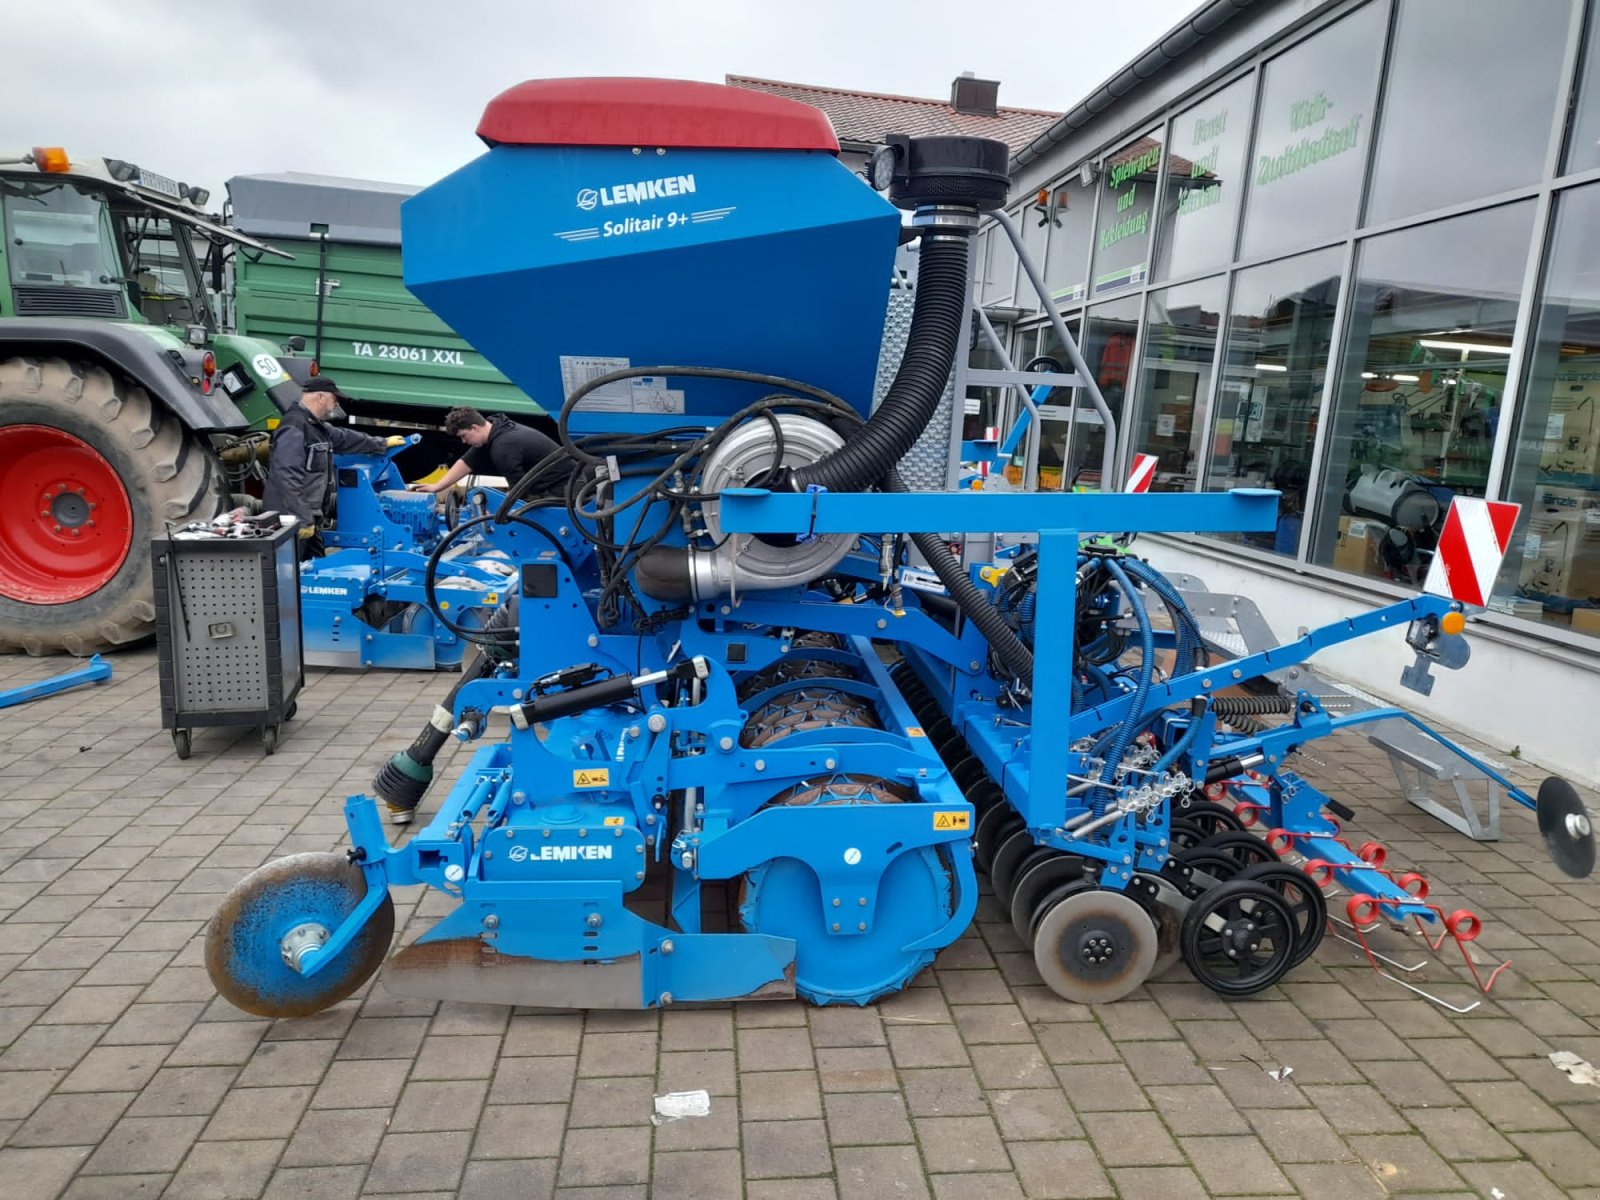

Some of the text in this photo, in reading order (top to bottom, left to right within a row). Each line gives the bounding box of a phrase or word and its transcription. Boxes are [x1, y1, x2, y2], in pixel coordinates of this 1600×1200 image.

[1110, 146, 1160, 189] Spielwaren
[600, 173, 696, 206] LEMKEN
[1117, 182, 1137, 213] und
[603, 211, 689, 237] Solitair 9+
[1099, 206, 1149, 251] Bekleidung
[256, 357, 278, 376] 50
[352, 342, 465, 365] TA 23061 XXL
[308, 586, 348, 596] LEMKEN
[530, 845, 613, 864] LEMKEN
